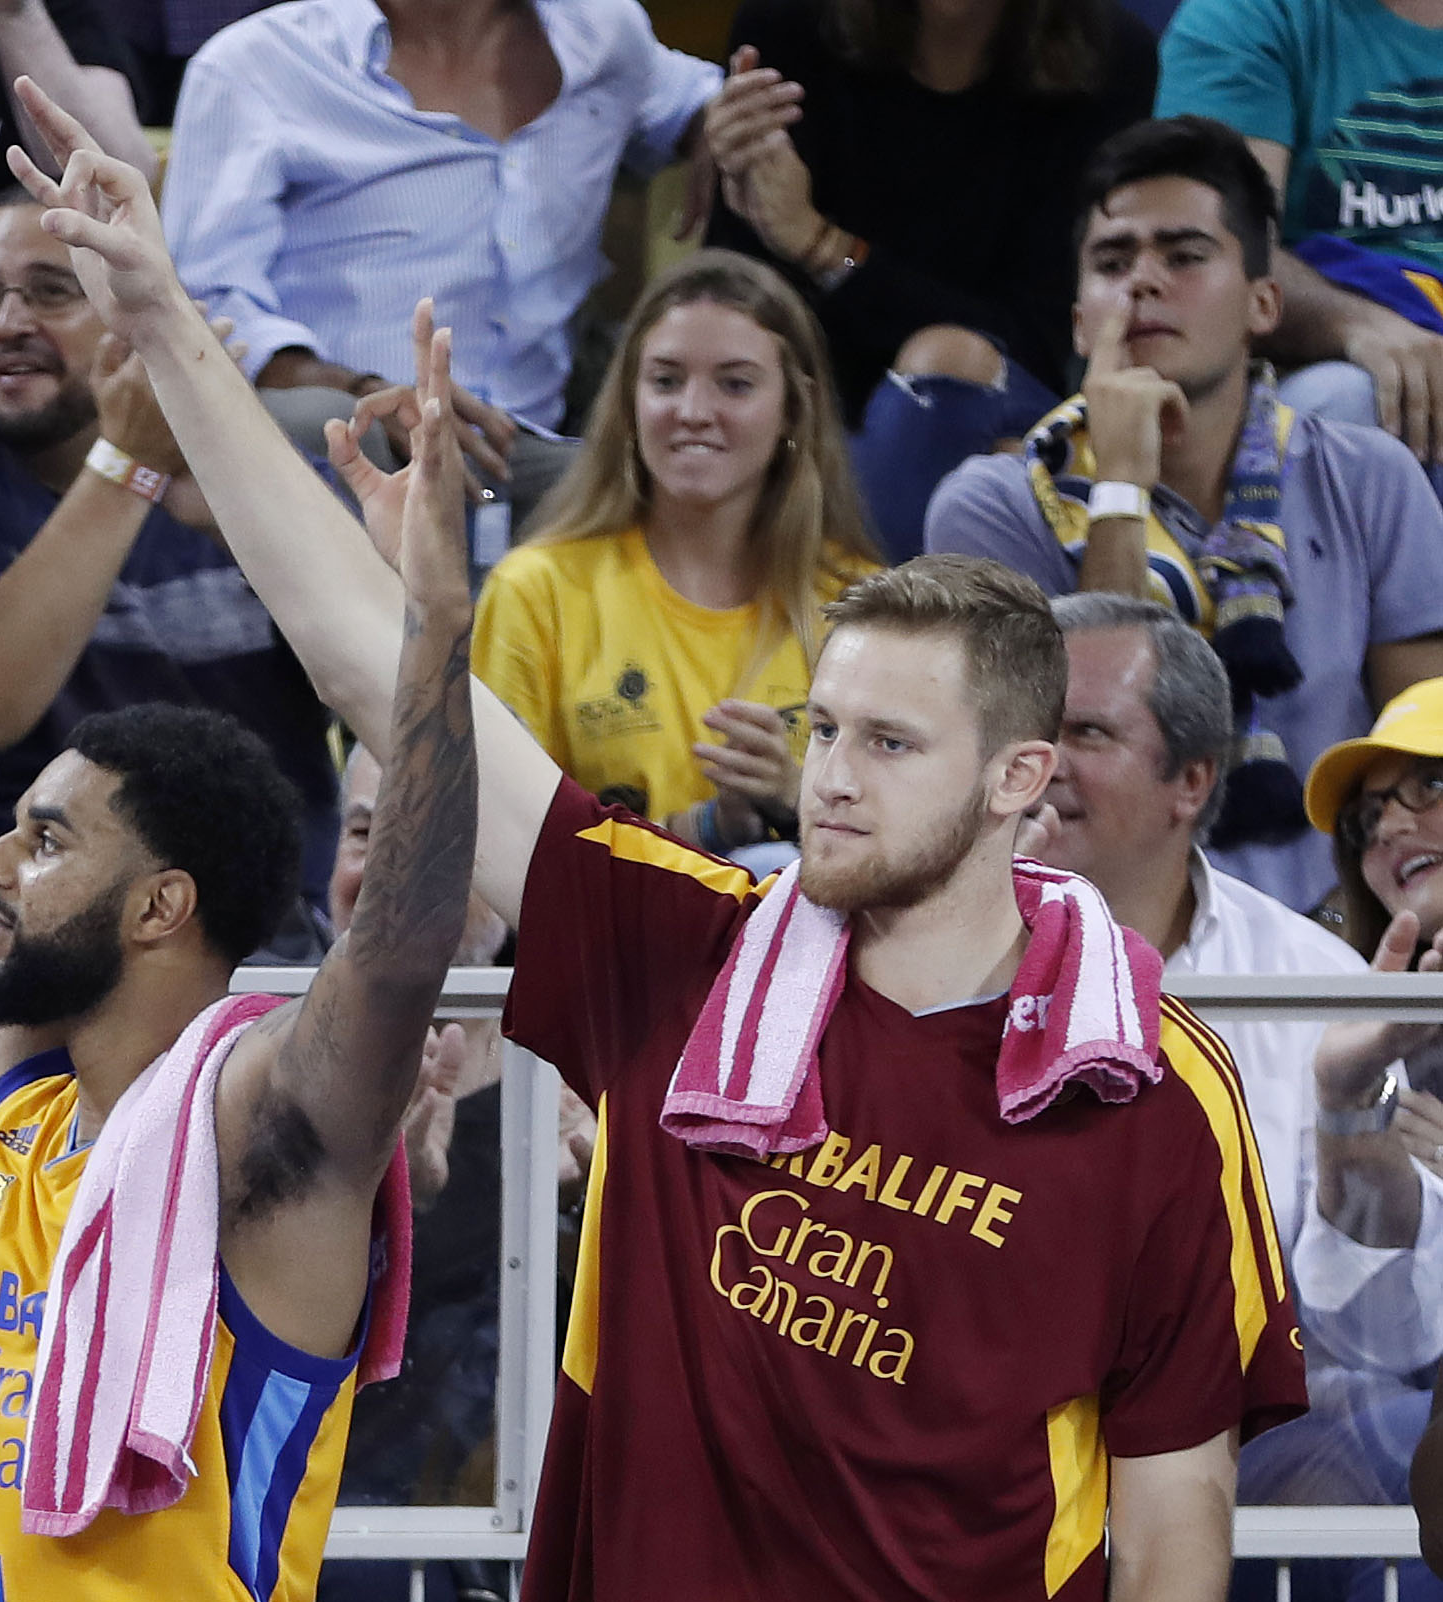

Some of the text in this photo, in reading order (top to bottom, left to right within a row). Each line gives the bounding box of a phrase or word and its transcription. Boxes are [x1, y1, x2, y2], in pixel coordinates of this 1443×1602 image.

[1339, 180, 1443, 229] Hurl
[740, 1189, 894, 1297] Gran
[760, 1130, 1024, 1249] BALIFE
[710, 1224, 915, 1385] Canaria
